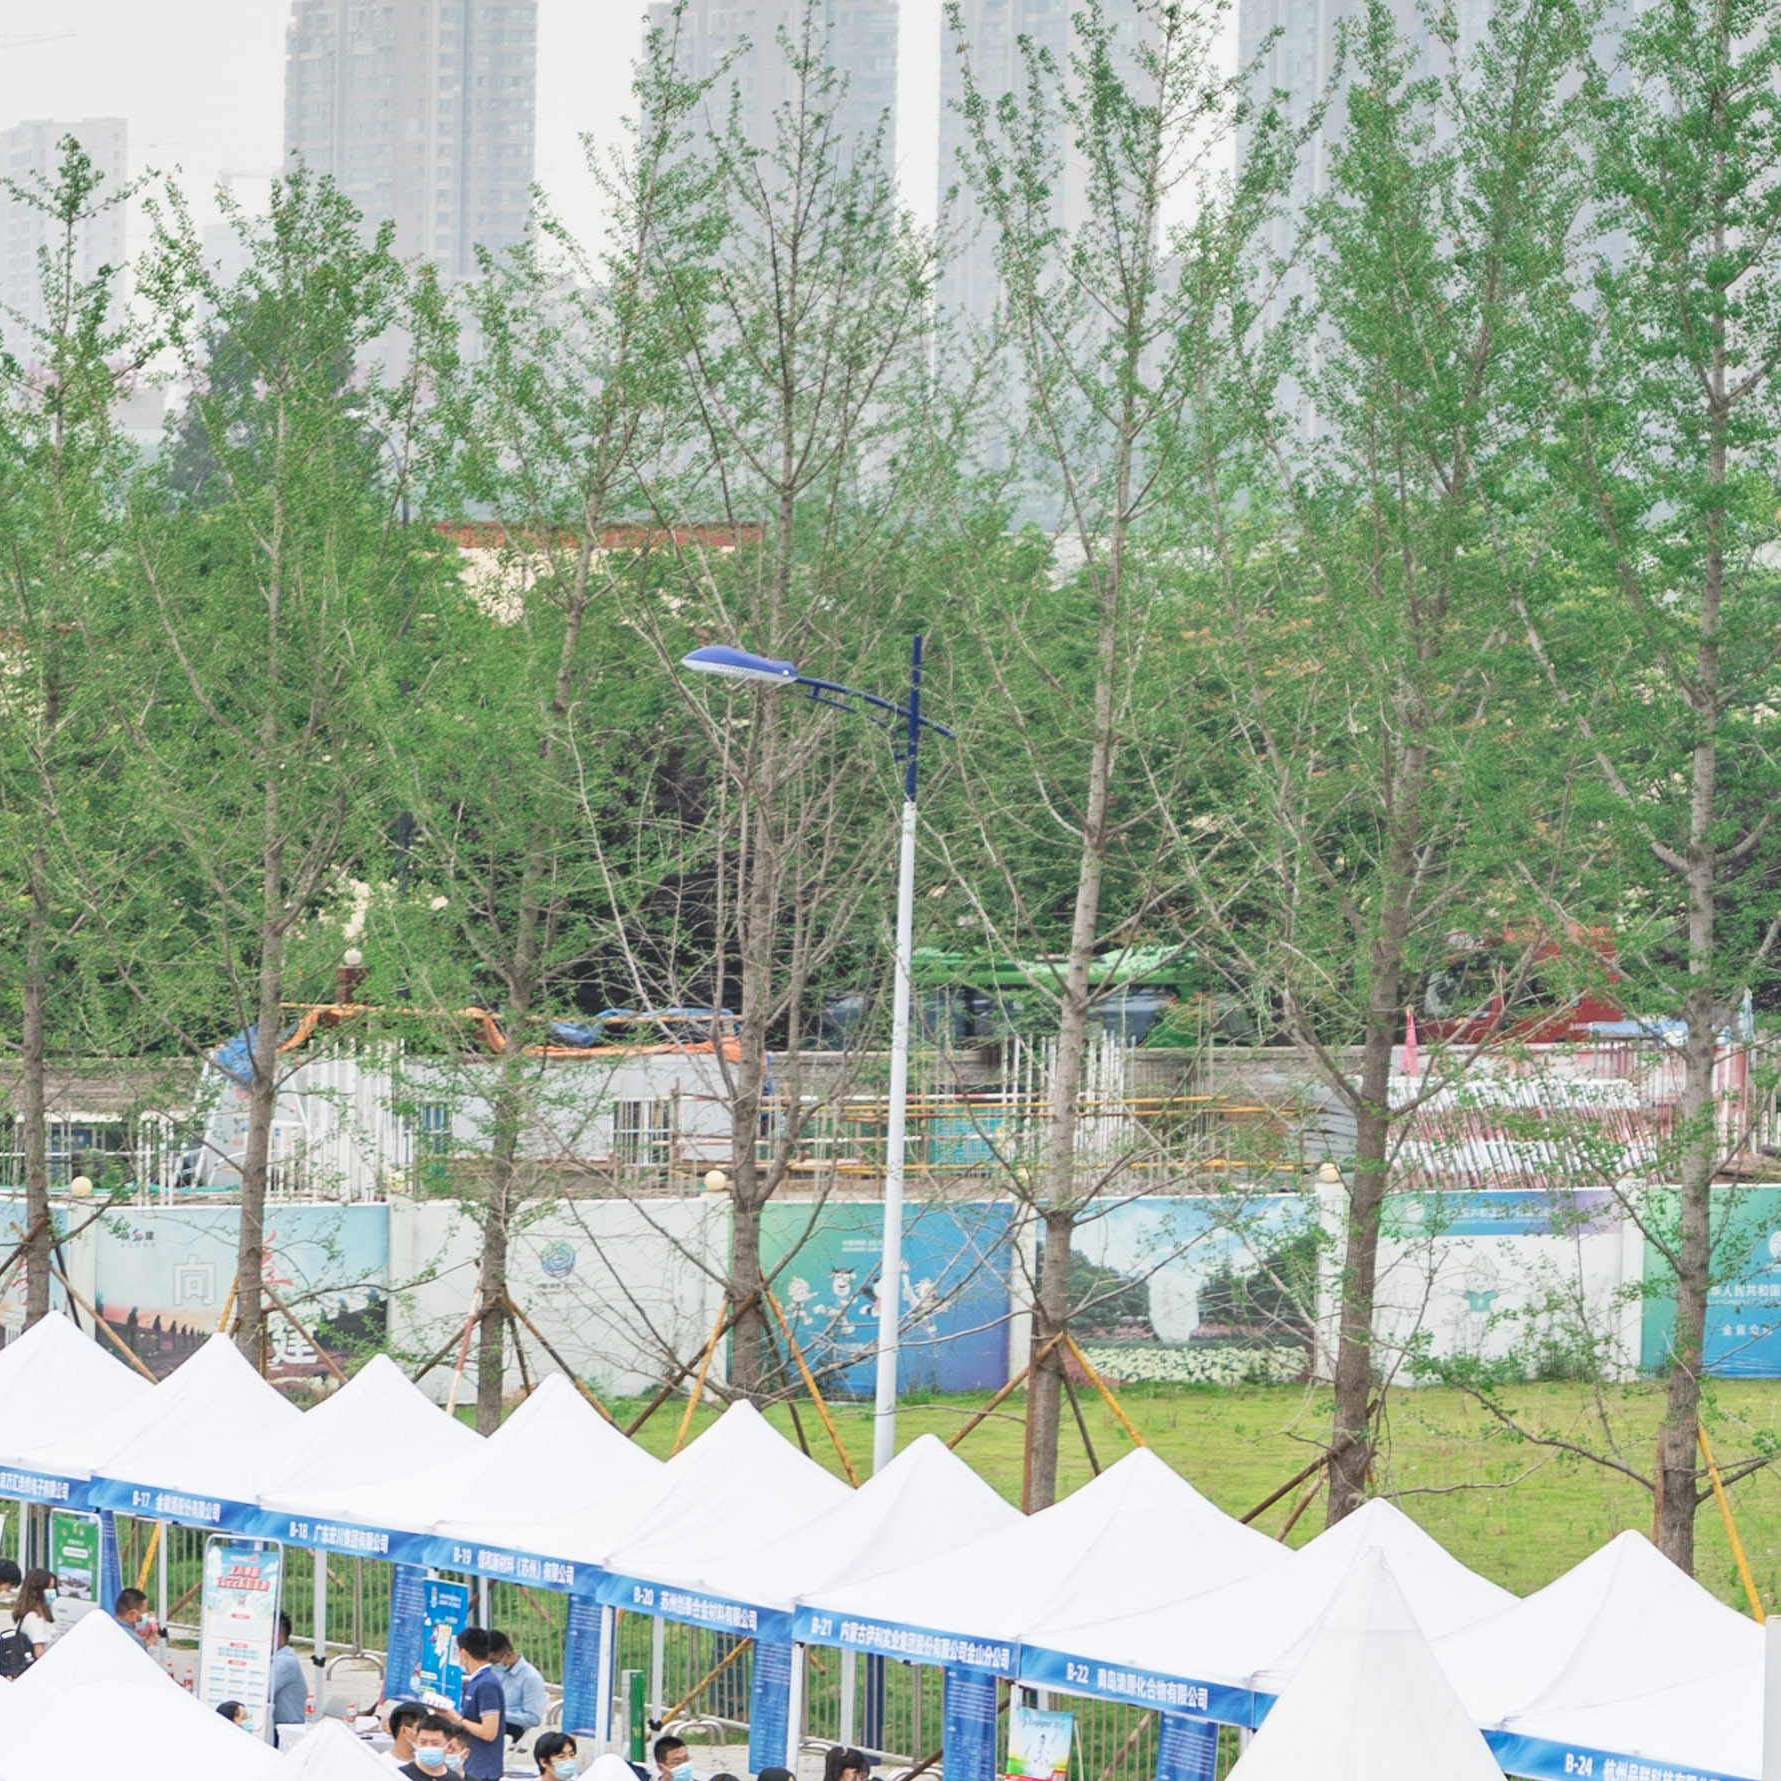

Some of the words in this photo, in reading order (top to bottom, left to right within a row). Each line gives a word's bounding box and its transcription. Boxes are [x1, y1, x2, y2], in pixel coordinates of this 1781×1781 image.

[173, 1255, 216, 1306] 向
[132, 1489, 151, 1507] B-17
[289, 1520, 308, 1539] B-18
[452, 1546, 472, 1565] B-19
[633, 1585, 655, 1606] B-20
[811, 1616, 833, 1637] B-21
[1066, 1661, 1089, 1685] B-22
[1564, 1752, 1594, 1777] B-24
